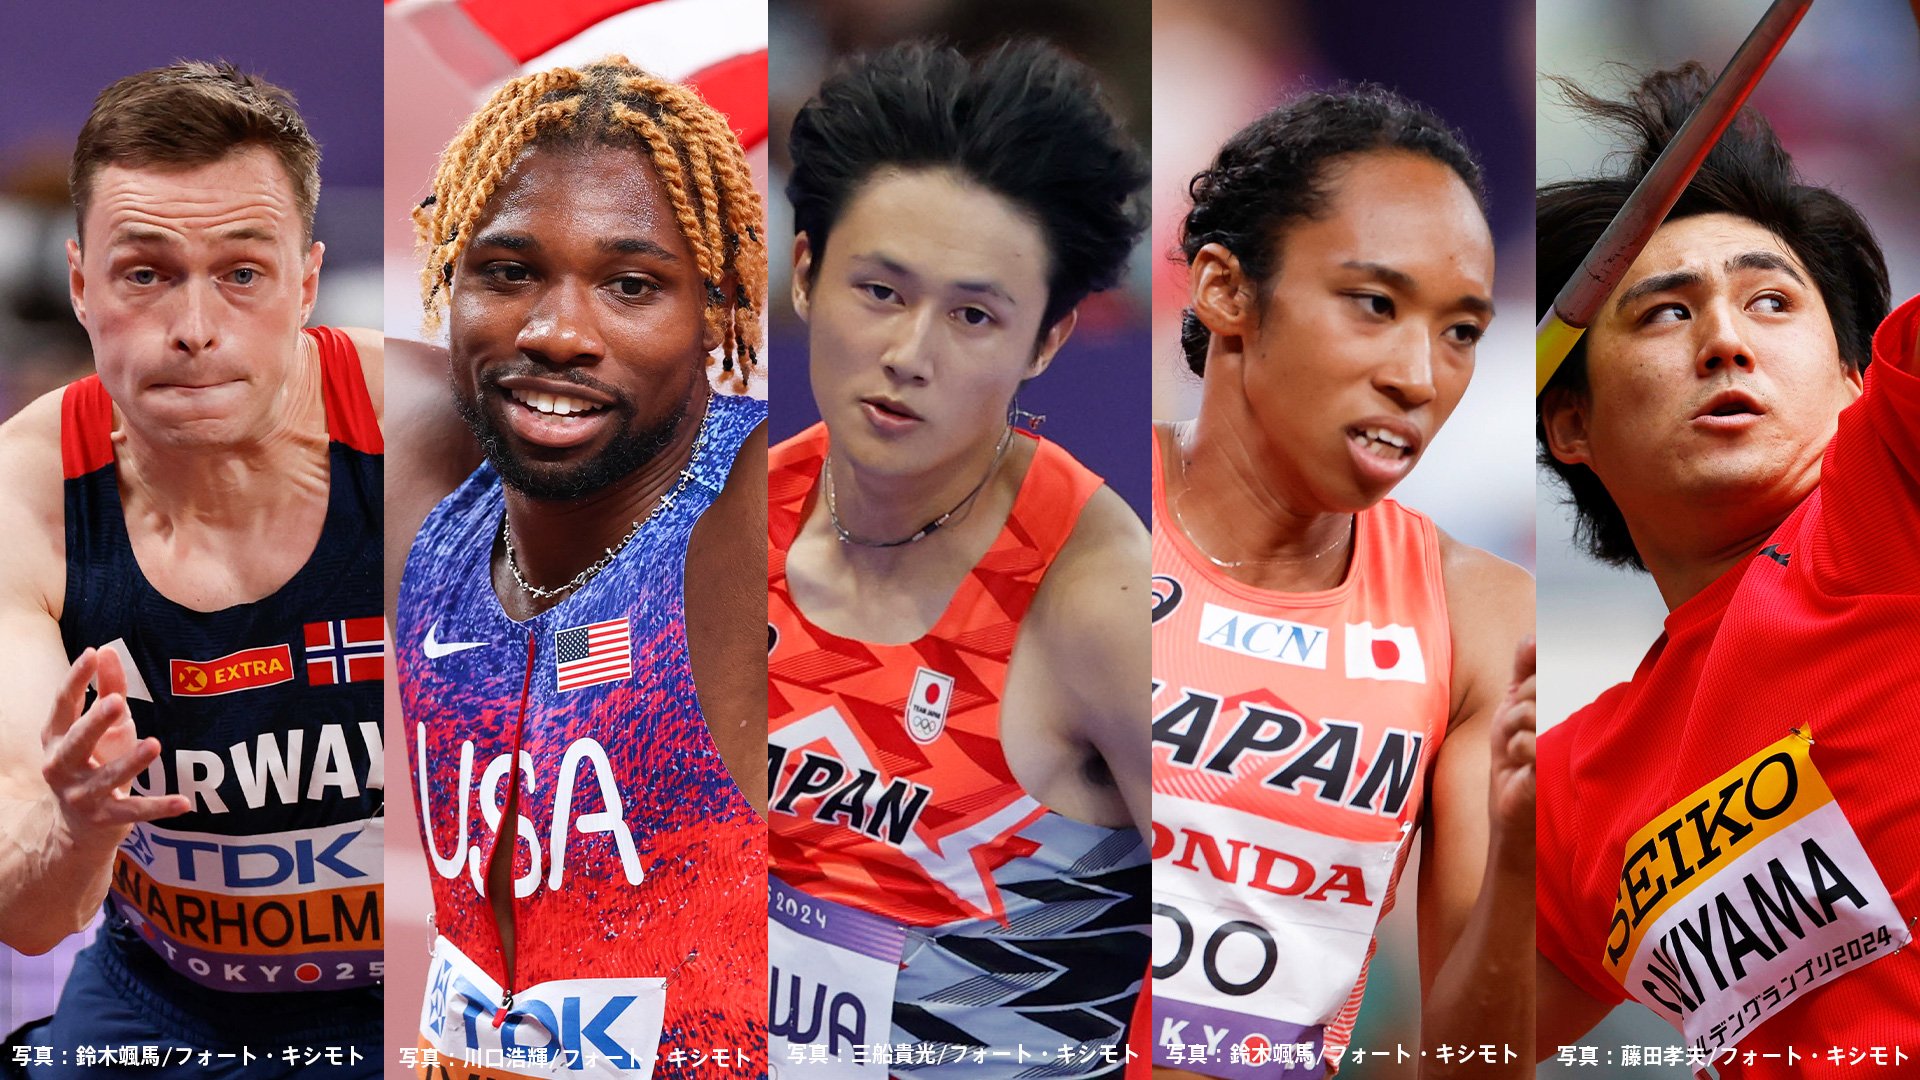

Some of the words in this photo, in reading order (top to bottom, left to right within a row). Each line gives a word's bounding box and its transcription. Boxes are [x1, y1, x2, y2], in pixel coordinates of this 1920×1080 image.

[215, 658, 284, 684] EXTRA
[1204, 615, 1324, 662] ACN
[417, 721, 644, 898] USA
[150, 830, 368, 888] TDK
[1607, 752, 1799, 967] SEIKO
[113, 860, 381, 948] WARHOLM
[776, 892, 827, 929] 2024
[452, 974, 641, 1070] TDK
[768, 965, 866, 1066] WA
